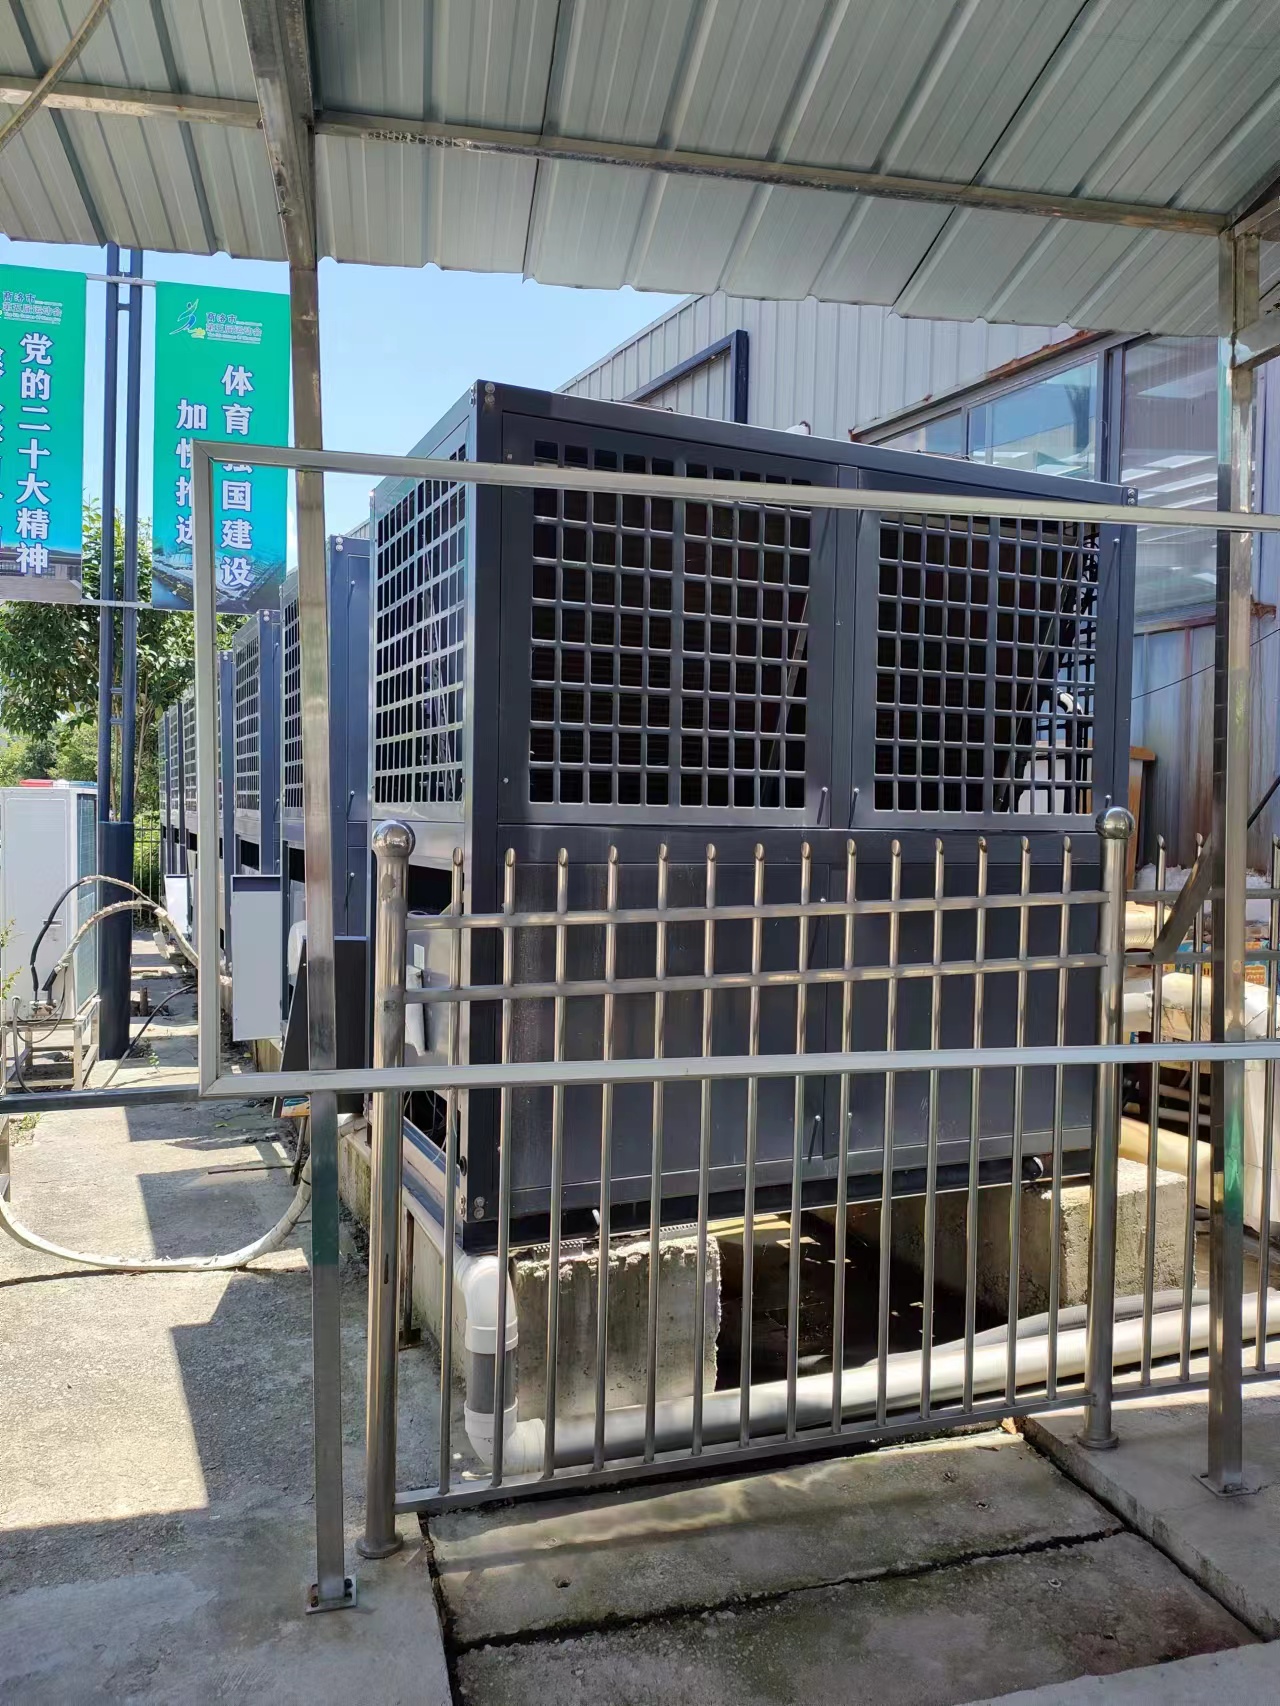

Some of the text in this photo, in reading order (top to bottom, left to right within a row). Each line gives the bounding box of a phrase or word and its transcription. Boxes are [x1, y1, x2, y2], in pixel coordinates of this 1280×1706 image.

[16, 332, 52, 575] 党的二十大精神
[221, 364, 253, 588] 体育国建设
